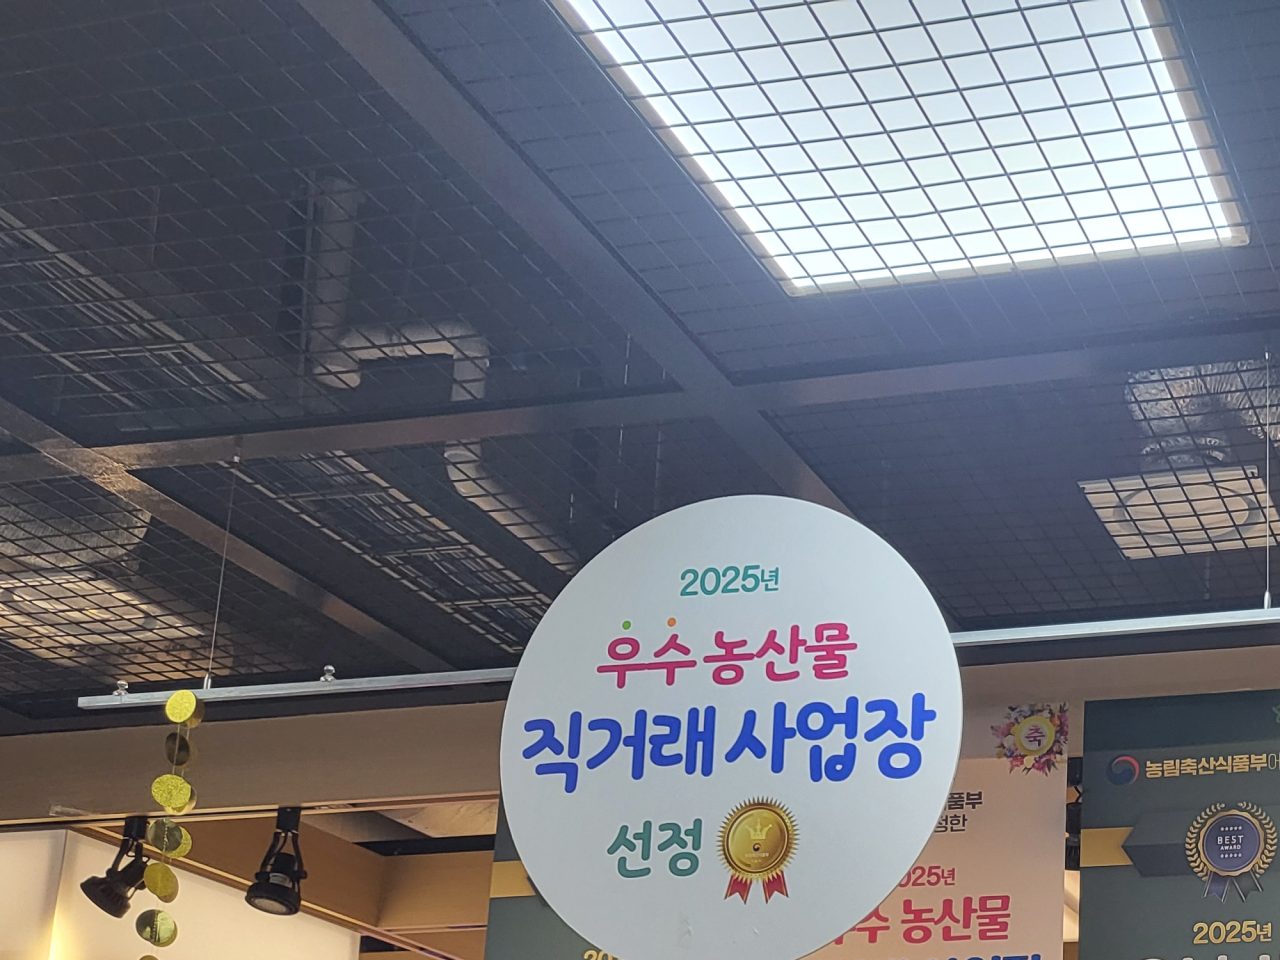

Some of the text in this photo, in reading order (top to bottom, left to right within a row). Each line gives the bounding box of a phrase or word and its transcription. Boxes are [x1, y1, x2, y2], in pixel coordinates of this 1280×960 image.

[680, 565, 780, 597] 2025년
[597, 622, 858, 689] 우수 농산물
[522, 692, 937, 793] 직거래 사업장
[607, 818, 703, 878] 선정
[1217, 835, 1244, 845] BEST
[901, 895, 1011, 944] 농산물
[1193, 921, 1273, 945] 2025년
